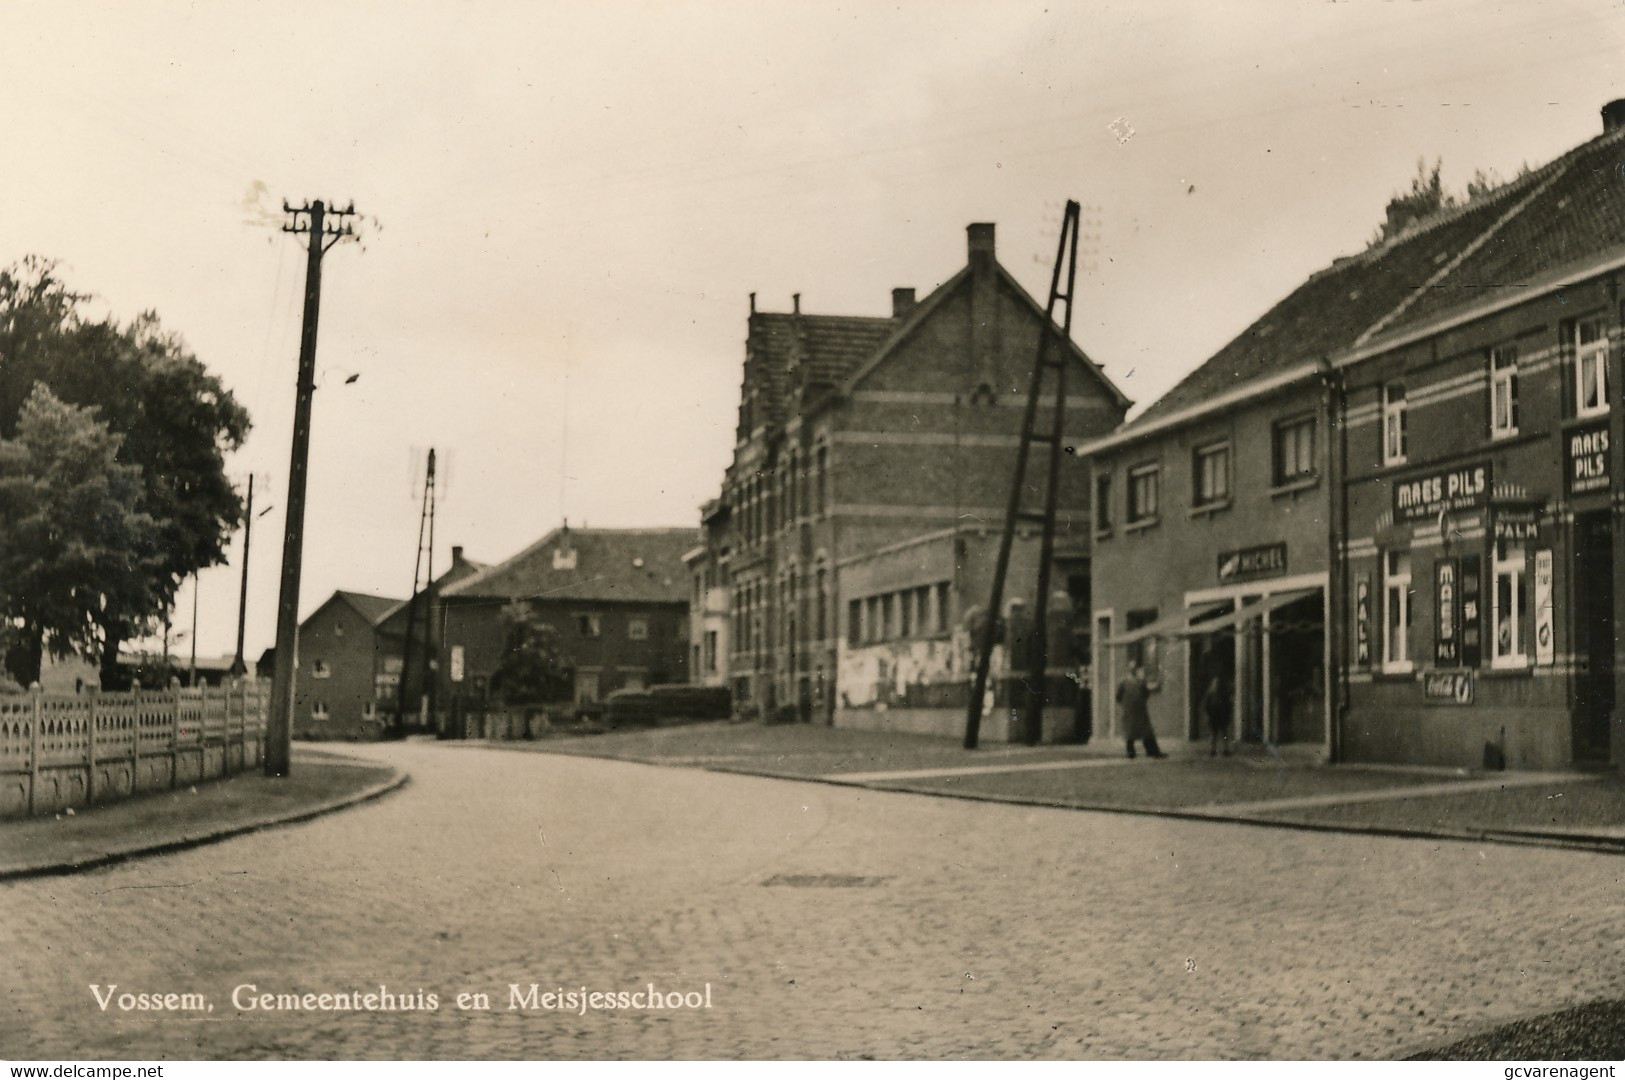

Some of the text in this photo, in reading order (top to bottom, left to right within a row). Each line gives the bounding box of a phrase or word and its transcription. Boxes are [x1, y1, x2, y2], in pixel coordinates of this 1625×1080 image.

[1571, 429, 1609, 457] MAES
[1575, 453, 1604, 479] PILS
[1398, 477, 1442, 509] MAES
[1448, 467, 1485, 498] PILS
[1495, 521, 1538, 539] PALM
